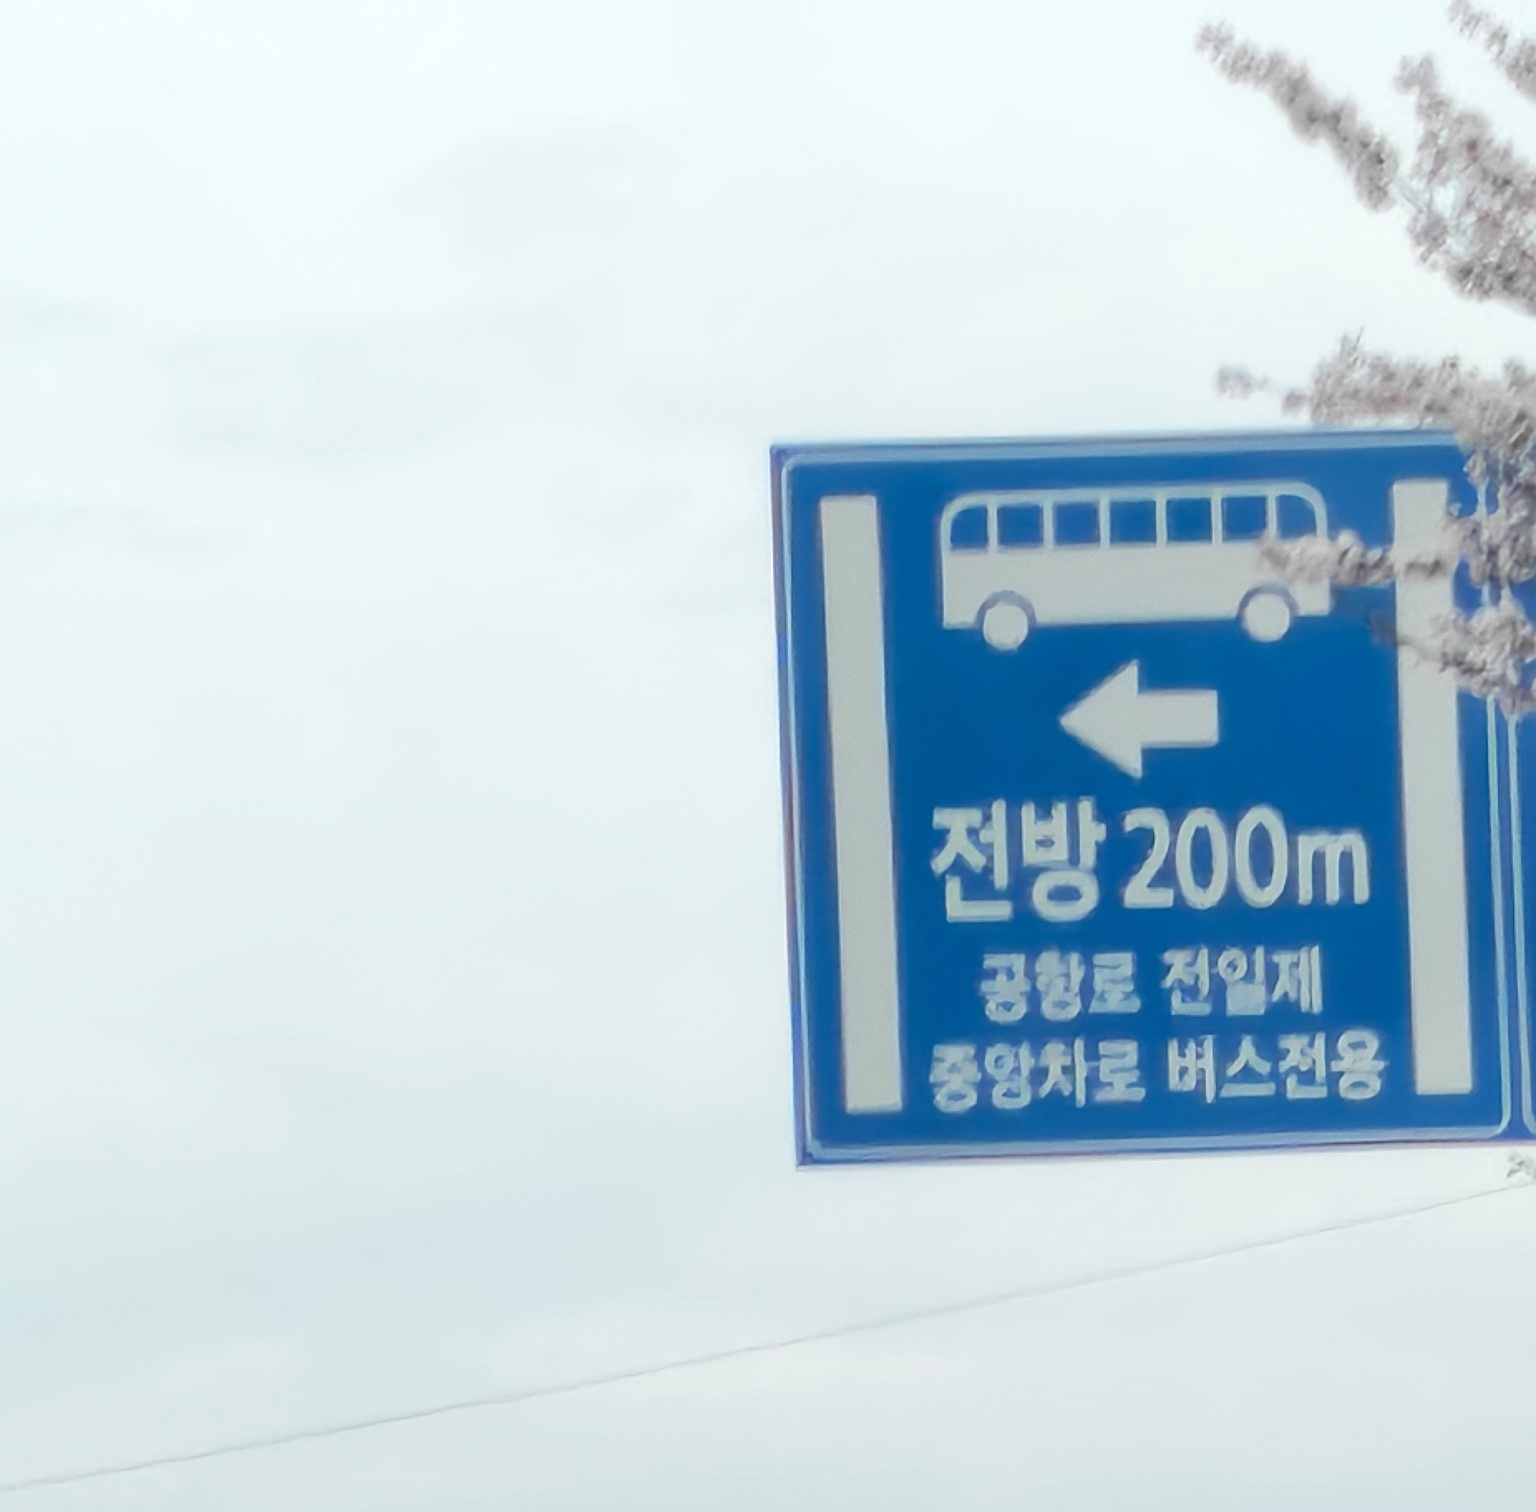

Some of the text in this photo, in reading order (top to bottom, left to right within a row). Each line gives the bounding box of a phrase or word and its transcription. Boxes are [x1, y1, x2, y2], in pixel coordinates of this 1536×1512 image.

[930, 797, 1371, 923] 전방 200m
[980, 944, 1323, 1023] 공항로 전일제
[929, 1028, 1390, 1113] 중앙차로 버스전용
